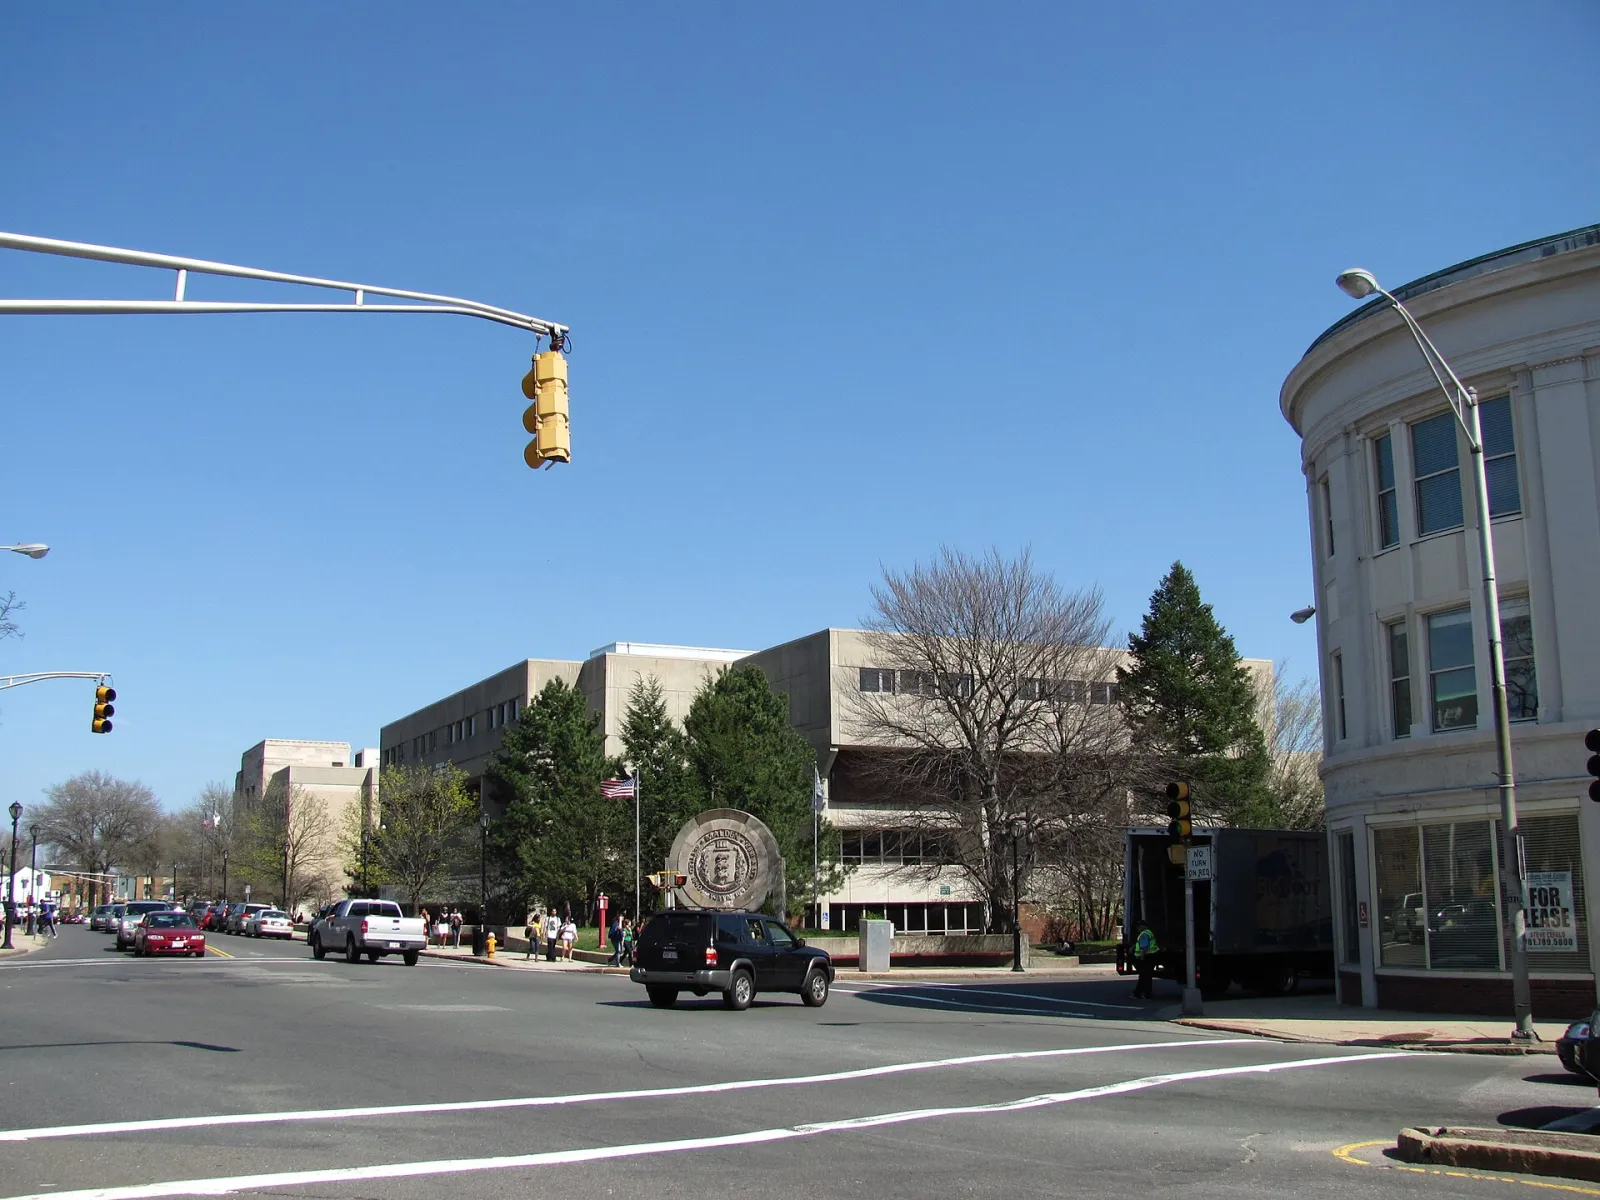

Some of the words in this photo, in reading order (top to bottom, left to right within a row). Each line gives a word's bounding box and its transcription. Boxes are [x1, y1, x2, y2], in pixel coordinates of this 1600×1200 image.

[704, 829, 739, 843] MALDEN
[1529, 887, 1560, 907] FOR
[1523, 907, 1570, 928] LEASE
